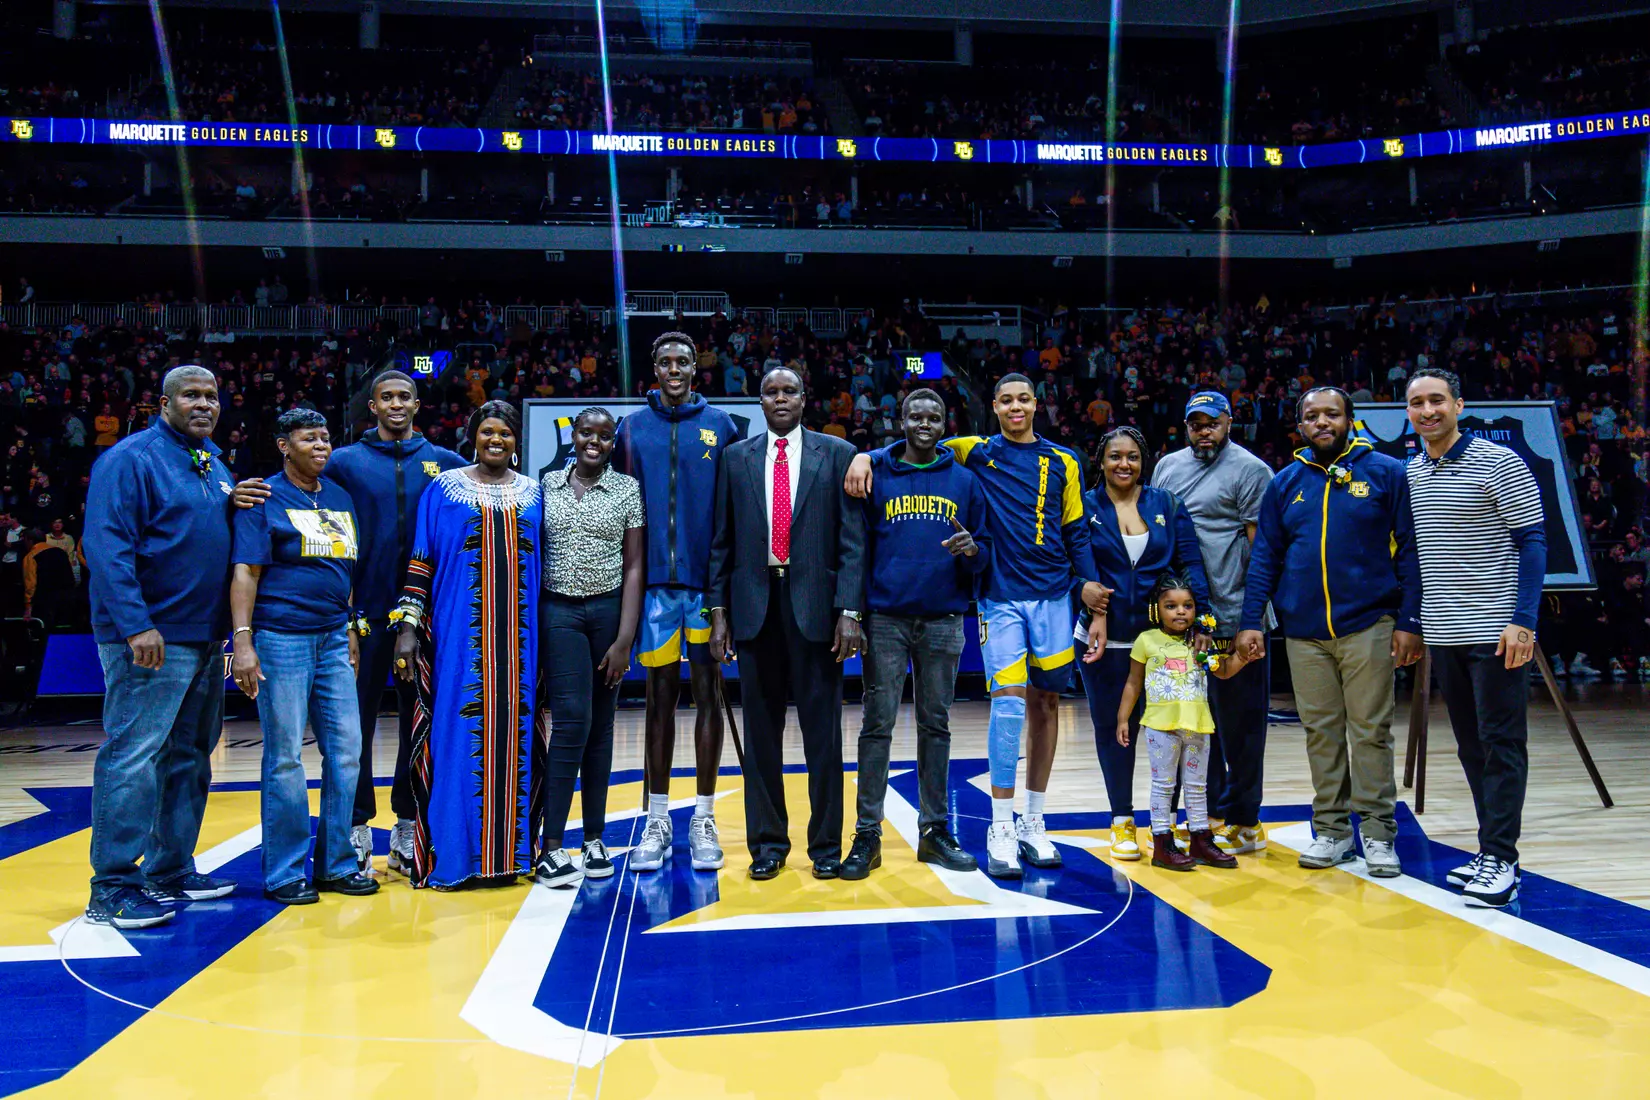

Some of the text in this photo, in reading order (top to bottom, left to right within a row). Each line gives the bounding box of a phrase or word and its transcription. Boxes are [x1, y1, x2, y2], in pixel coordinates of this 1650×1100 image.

[11, 119, 34, 139] MU
[109, 123, 308, 142] MARQUETTE GOLDEN EAGLES
[375, 128, 397, 148] MU
[1475, 122, 1552, 147] MARQUETTE
[1557, 118, 1615, 136] GOLDEN
[502, 131, 523, 151] MU
[592, 134, 776, 153] MARQUETTE GOLDEN EAGLES
[836, 138, 857, 158] MU
[953, 141, 974, 160] MU
[1383, 138, 1404, 157] MU
[1037, 143, 1208, 162] MARQUETTE GOLDEN EAGLES
[1264, 147, 1283, 166] MU
[413, 356, 433, 374] MU
[906, 357, 925, 375] MU
[1473, 429, 1511, 441] ELLIOTT
[885, 495, 958, 526] MARQUETTE BASKETBALL
